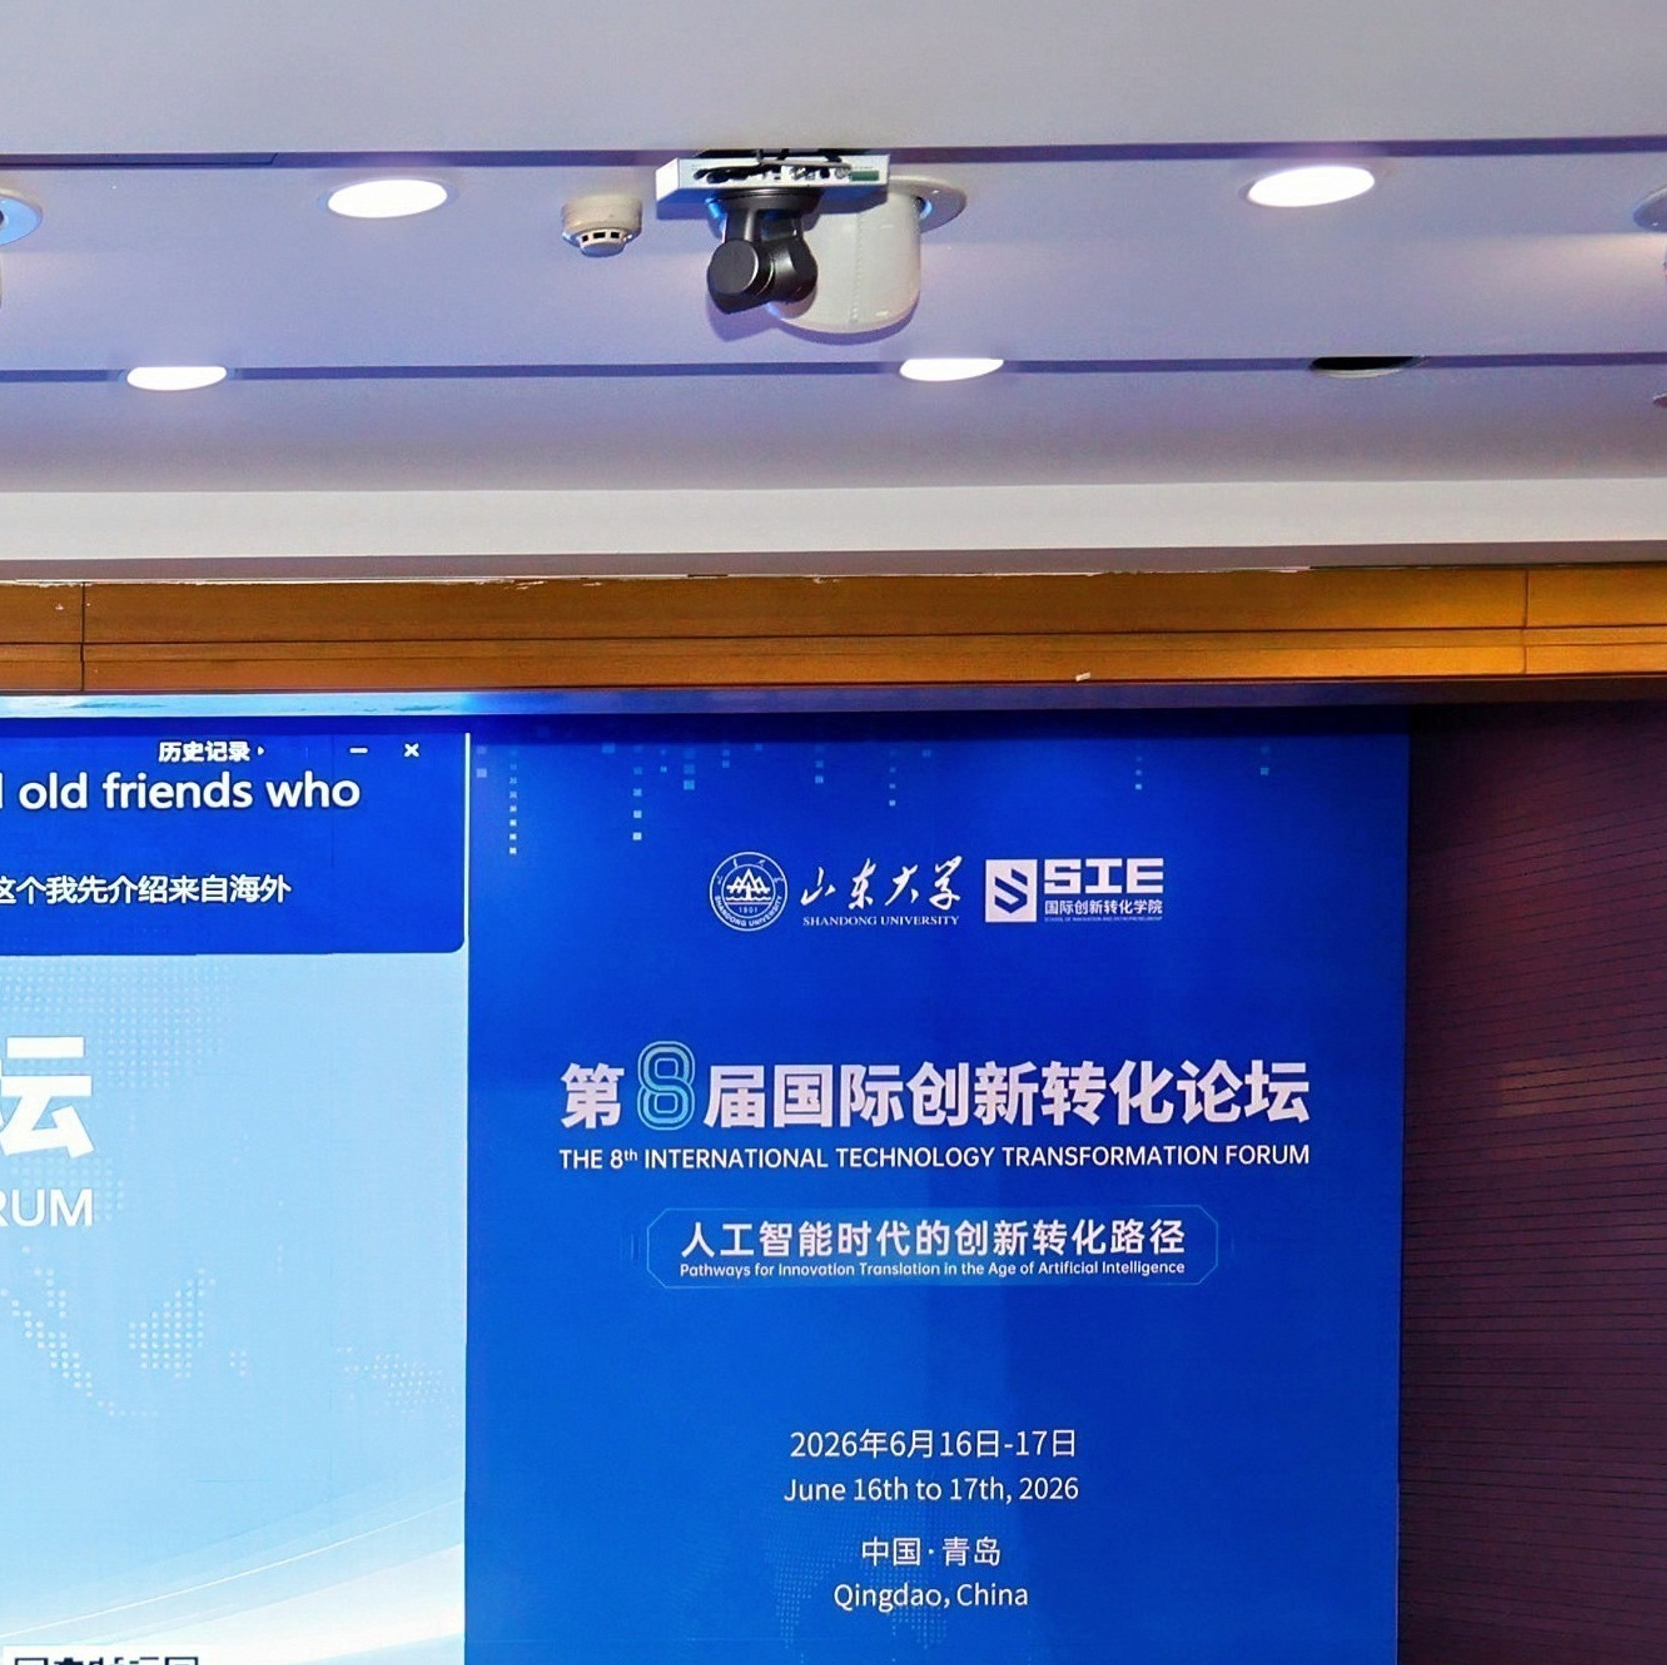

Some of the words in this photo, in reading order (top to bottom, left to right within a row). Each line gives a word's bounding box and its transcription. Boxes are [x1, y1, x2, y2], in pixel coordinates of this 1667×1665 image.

[159, 741, 250, 762] 历史记录
[20, 773, 86, 808] old
[103, 772, 252, 808] friends
[267, 772, 359, 806] who
[1045, 858, 1163, 894] SIE
[1045, 900, 1162, 914] 国际创新转化学院
[803, 916, 878, 926] SHANDONG
[880, 916, 959, 926] UNIVERSITY
[560, 1150, 602, 1168] THE
[611, 1149, 637, 1169] 8th
[646, 1149, 828, 1168] INTERNATIONAL
[836, 1147, 994, 1167] TECHNOLOGY
[1002, 1146, 1217, 1166] TRANSFORMATION
[1226, 1145, 1308, 1164] FORUM
[682, 1219, 1184, 1257] 人工智能时代的创新转化路径
[681, 1265, 750, 1277] Pathways
[756, 1264, 773, 1275] for
[780, 1265, 854, 1274] Innovation
[861, 1263, 939, 1274] Translation
[944, 1263, 957, 1274] in
[963, 1263, 983, 1274] the
[989, 1263, 1015, 1277] Age
[1021, 1263, 1033, 1273] of
[1039, 1262, 1097, 1273] Artificial
[1103, 1262, 1184, 1275] Intelligence
[791, 1429, 1074, 1458] 2026年6月16日-17日
[785, 1480, 845, 1501] June
[855, 1477, 908, 1500] 16th
[916, 1480, 941, 1500] to
[951, 1477, 1011, 1504] 17th,
[1020, 1477, 1078, 1499] 2026
[835, 1583, 949, 1612] Qingdao,
[957, 1583, 1027, 1606] China
